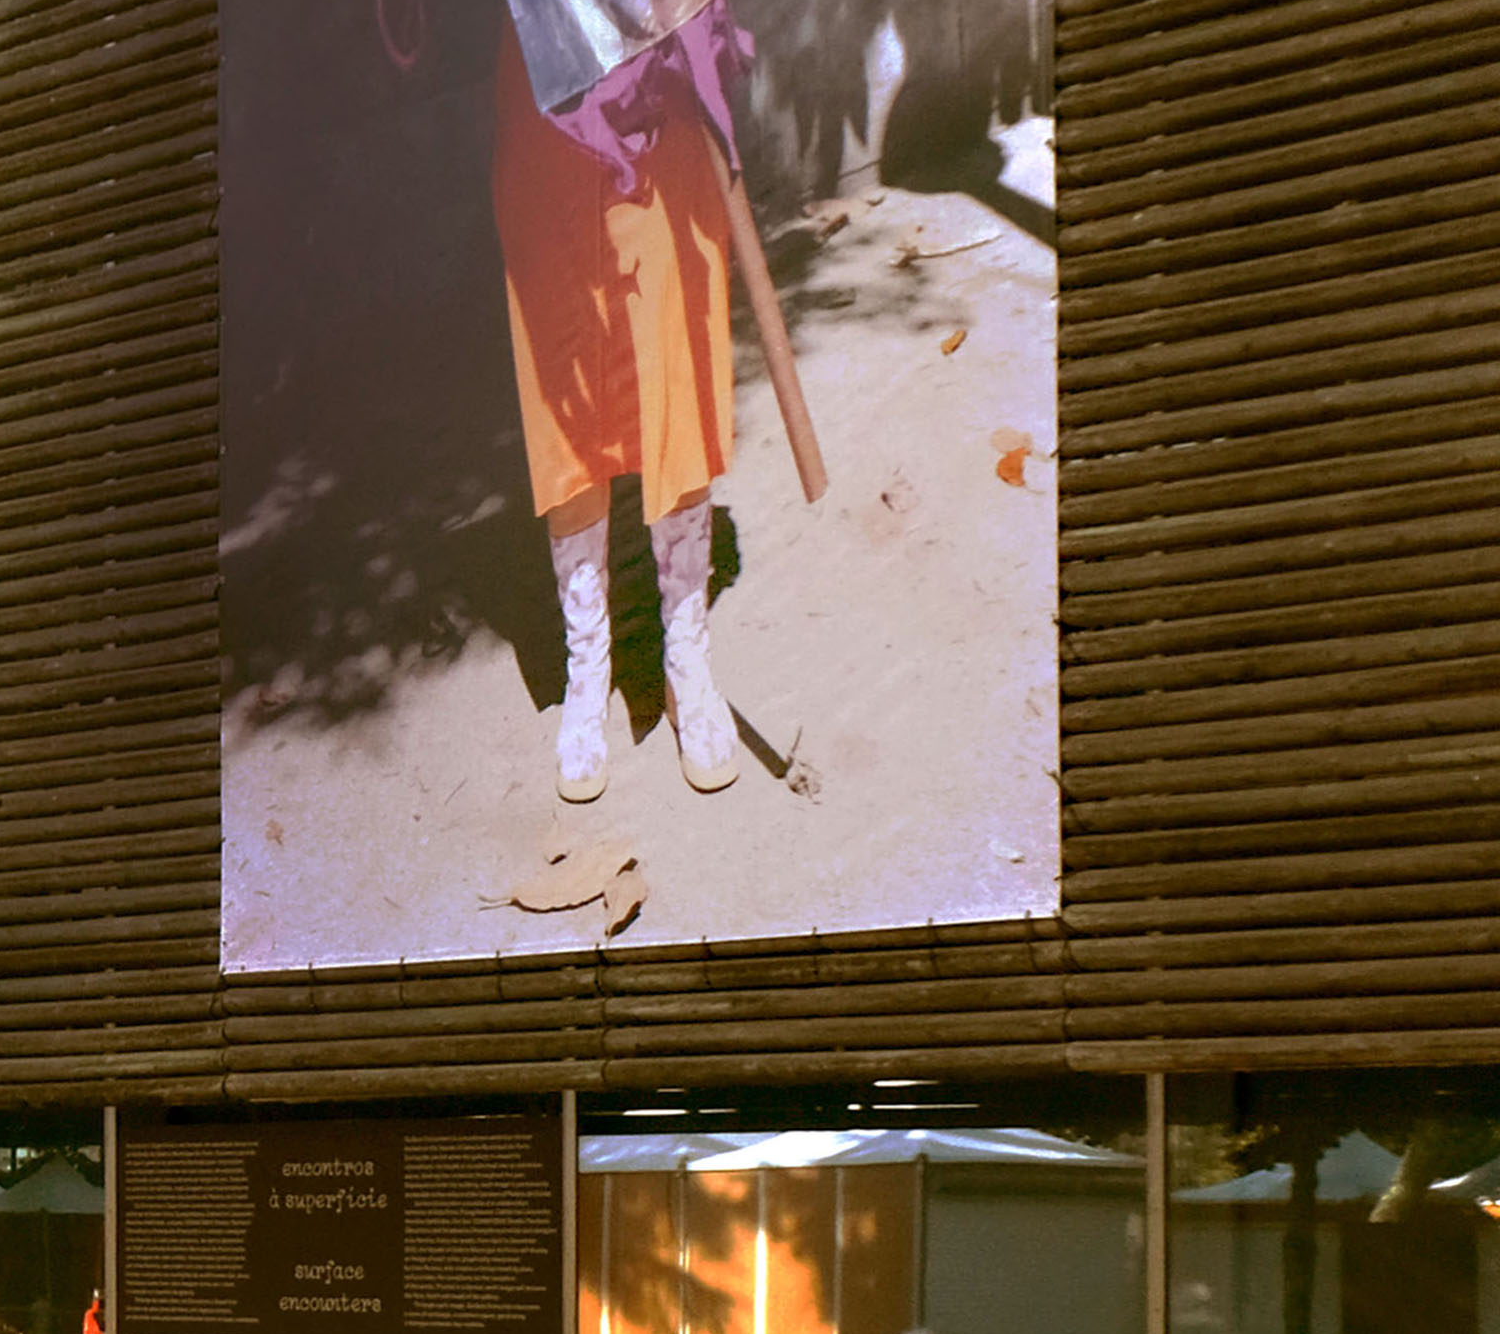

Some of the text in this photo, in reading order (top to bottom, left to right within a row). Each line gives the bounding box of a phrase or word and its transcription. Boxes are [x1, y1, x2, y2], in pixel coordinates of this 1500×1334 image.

[282, 1157, 374, 1176] encontros
[285, 1186, 388, 1214] superfície
[294, 1259, 365, 1284] surface
[278, 1293, 382, 1313] encounters
